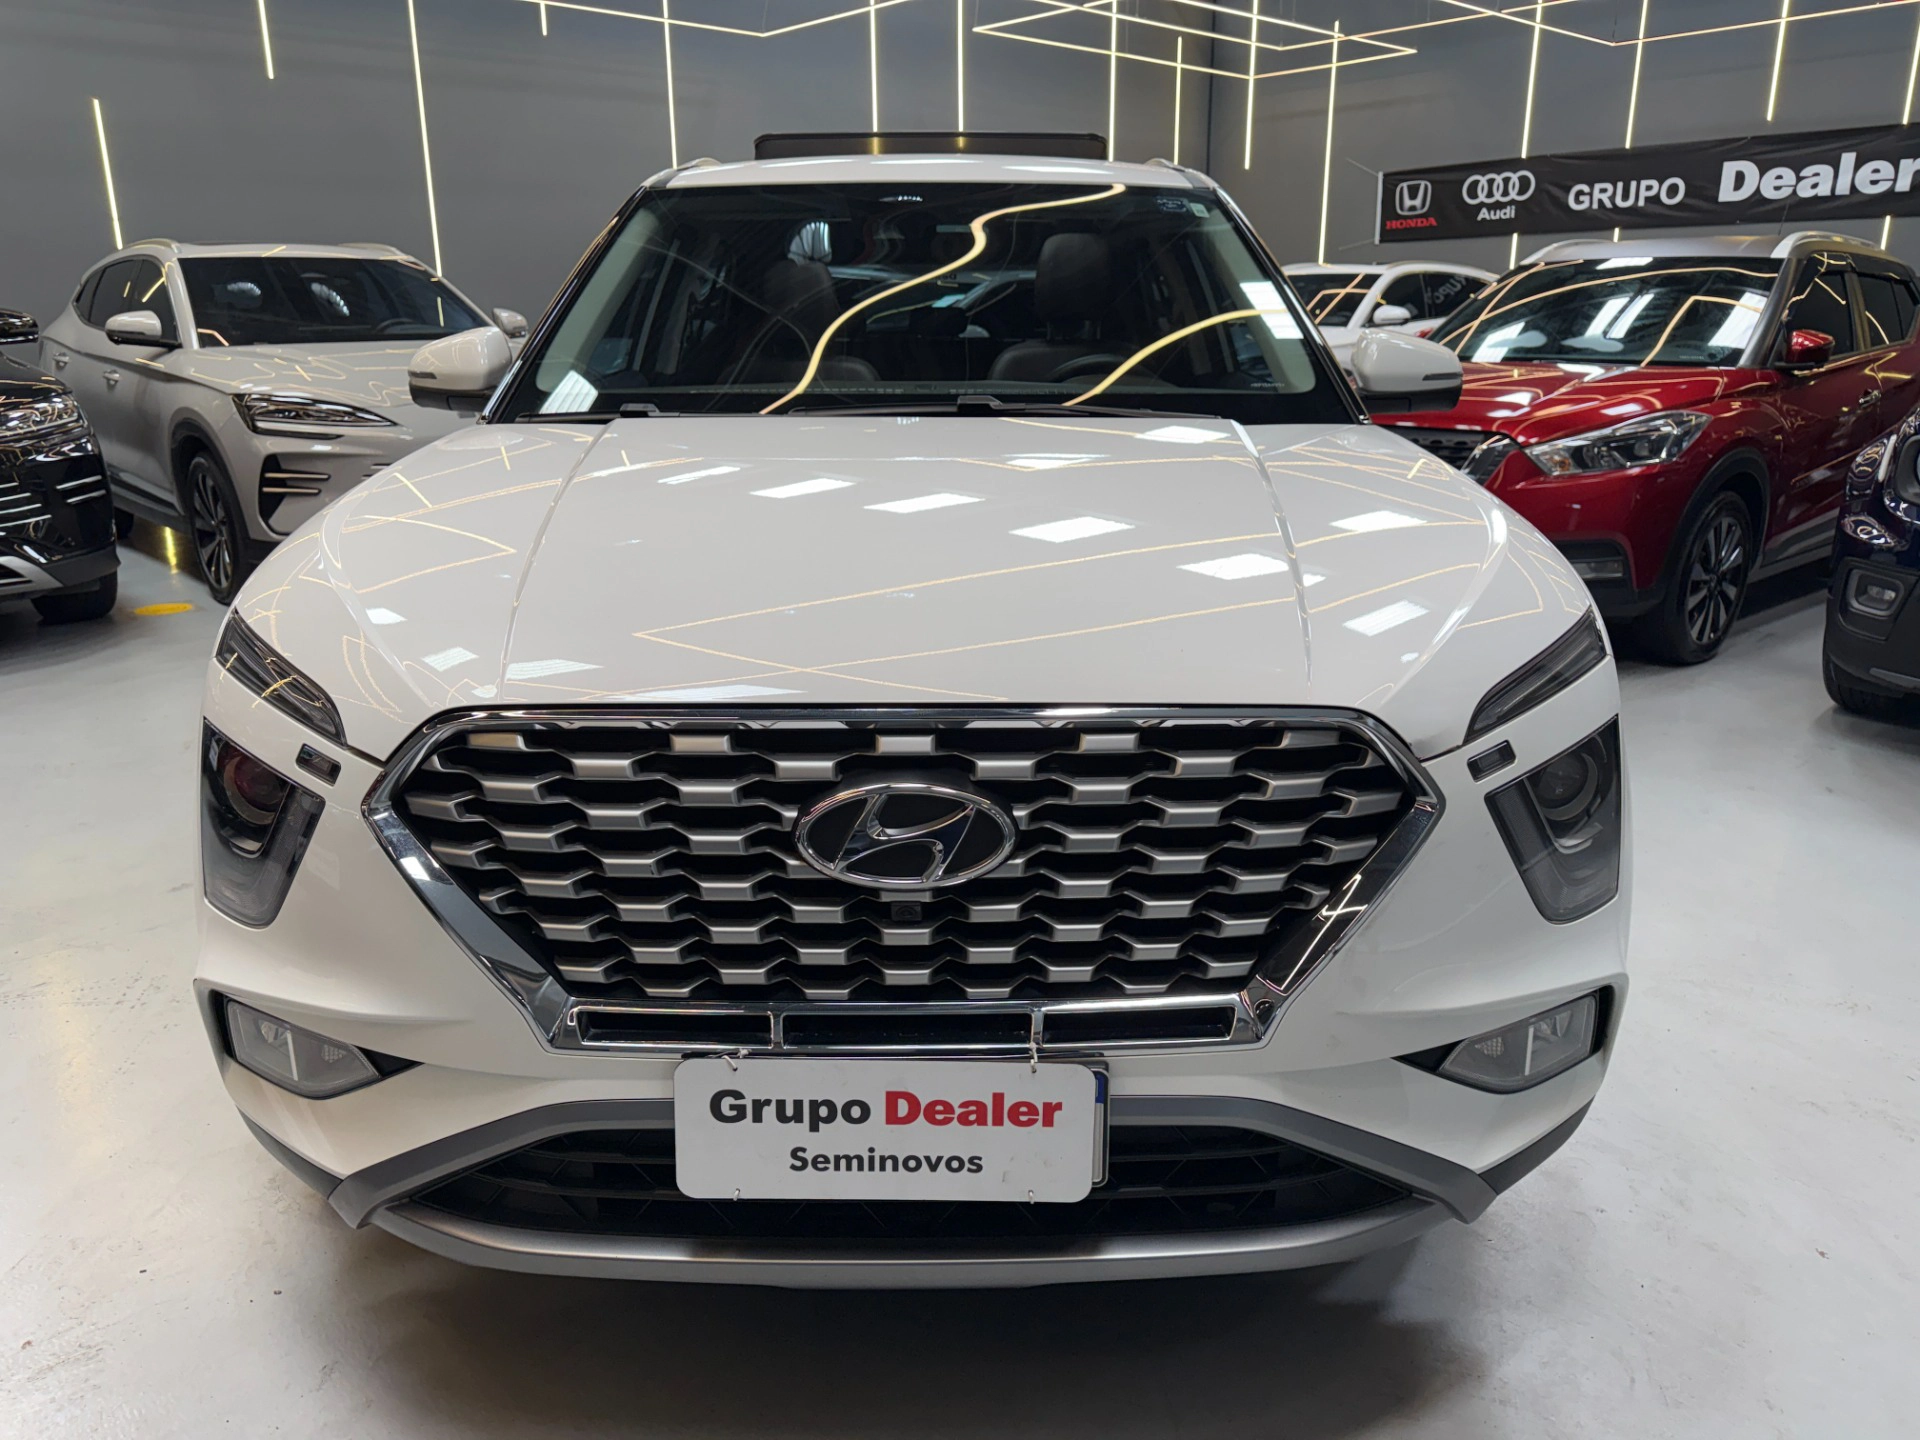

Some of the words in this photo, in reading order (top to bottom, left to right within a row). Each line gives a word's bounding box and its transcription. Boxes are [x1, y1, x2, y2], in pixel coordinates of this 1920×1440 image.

[1568, 177, 1686, 211] GRUPO
[1718, 152, 1920, 202] Dealer
[1385, 217, 1437, 230] HONDA
[1476, 205, 1516, 221] Audi
[709, 1089, 872, 1133] Grupo
[885, 1090, 1063, 1128] Dealer
[789, 1146, 984, 1174] Seminovos
